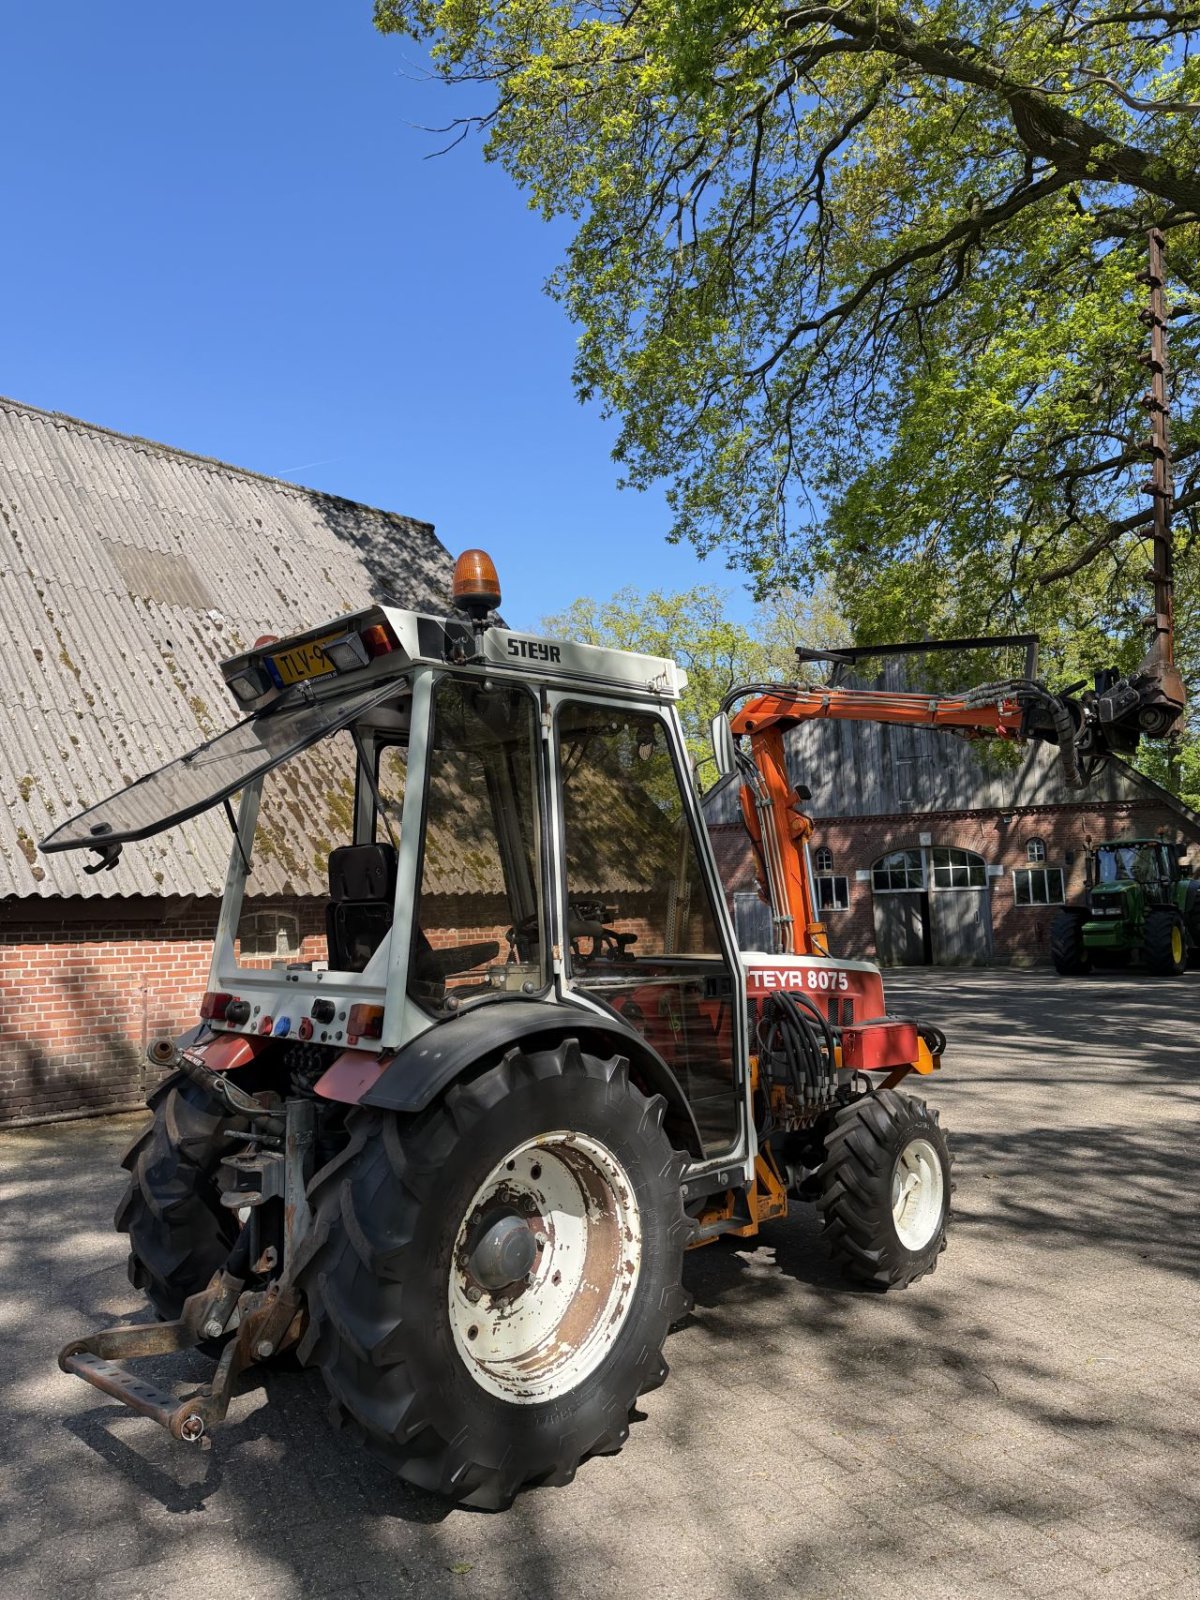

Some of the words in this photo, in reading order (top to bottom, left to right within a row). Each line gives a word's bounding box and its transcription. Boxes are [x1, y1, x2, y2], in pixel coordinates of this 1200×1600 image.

[280, 644, 326, 678] TLV-9
[507, 638, 561, 663] STEYR
[749, 970, 802, 988] TEYR
[807, 971, 849, 991] 8075
